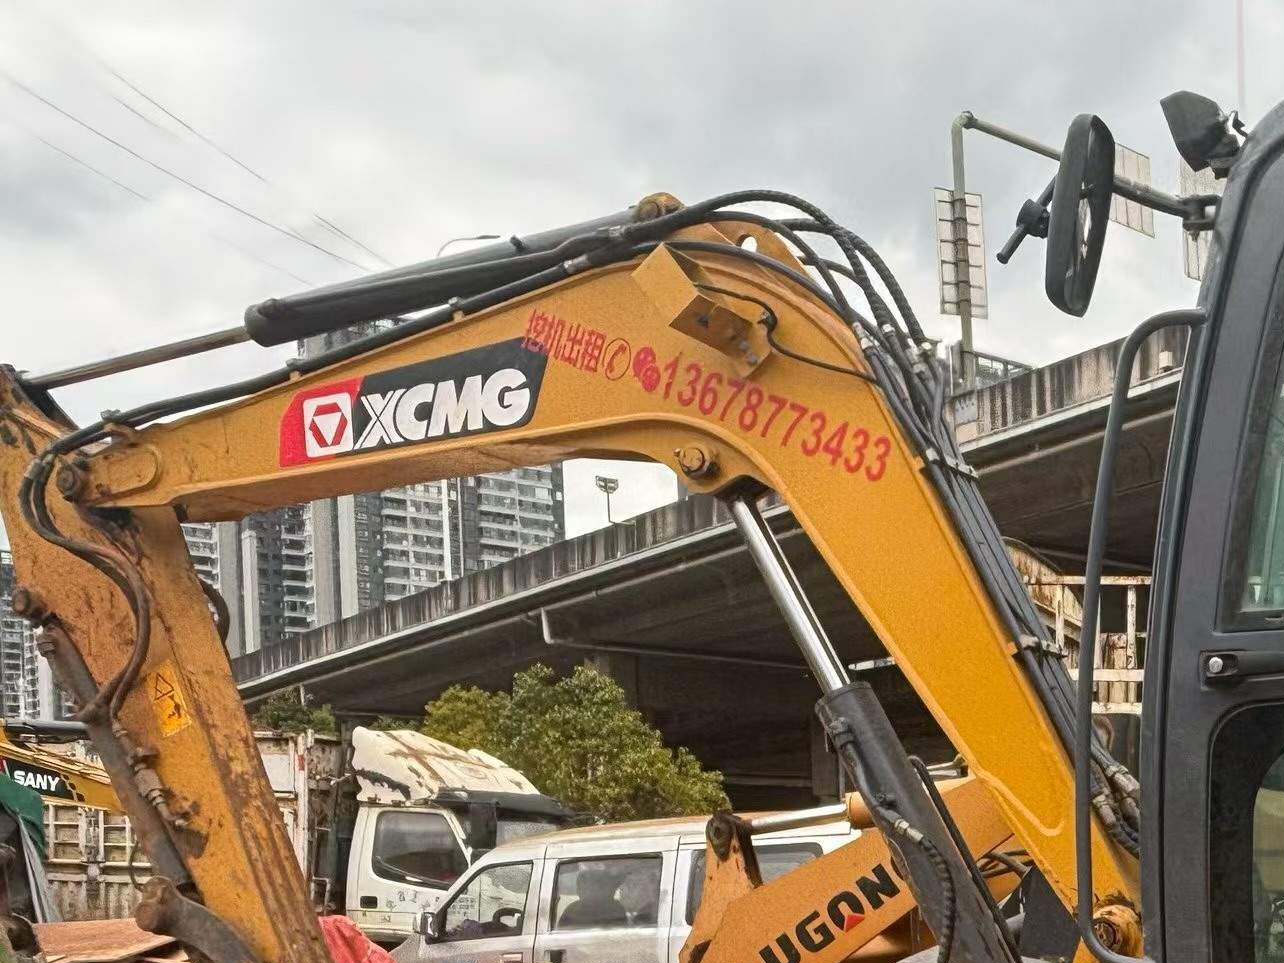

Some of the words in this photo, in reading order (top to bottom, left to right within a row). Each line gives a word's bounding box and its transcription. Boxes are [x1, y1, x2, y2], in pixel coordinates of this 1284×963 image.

[353, 367, 531, 450] XCMG
[663, 352, 892, 482] 13678773433
[13, 770, 60, 791] SANY
